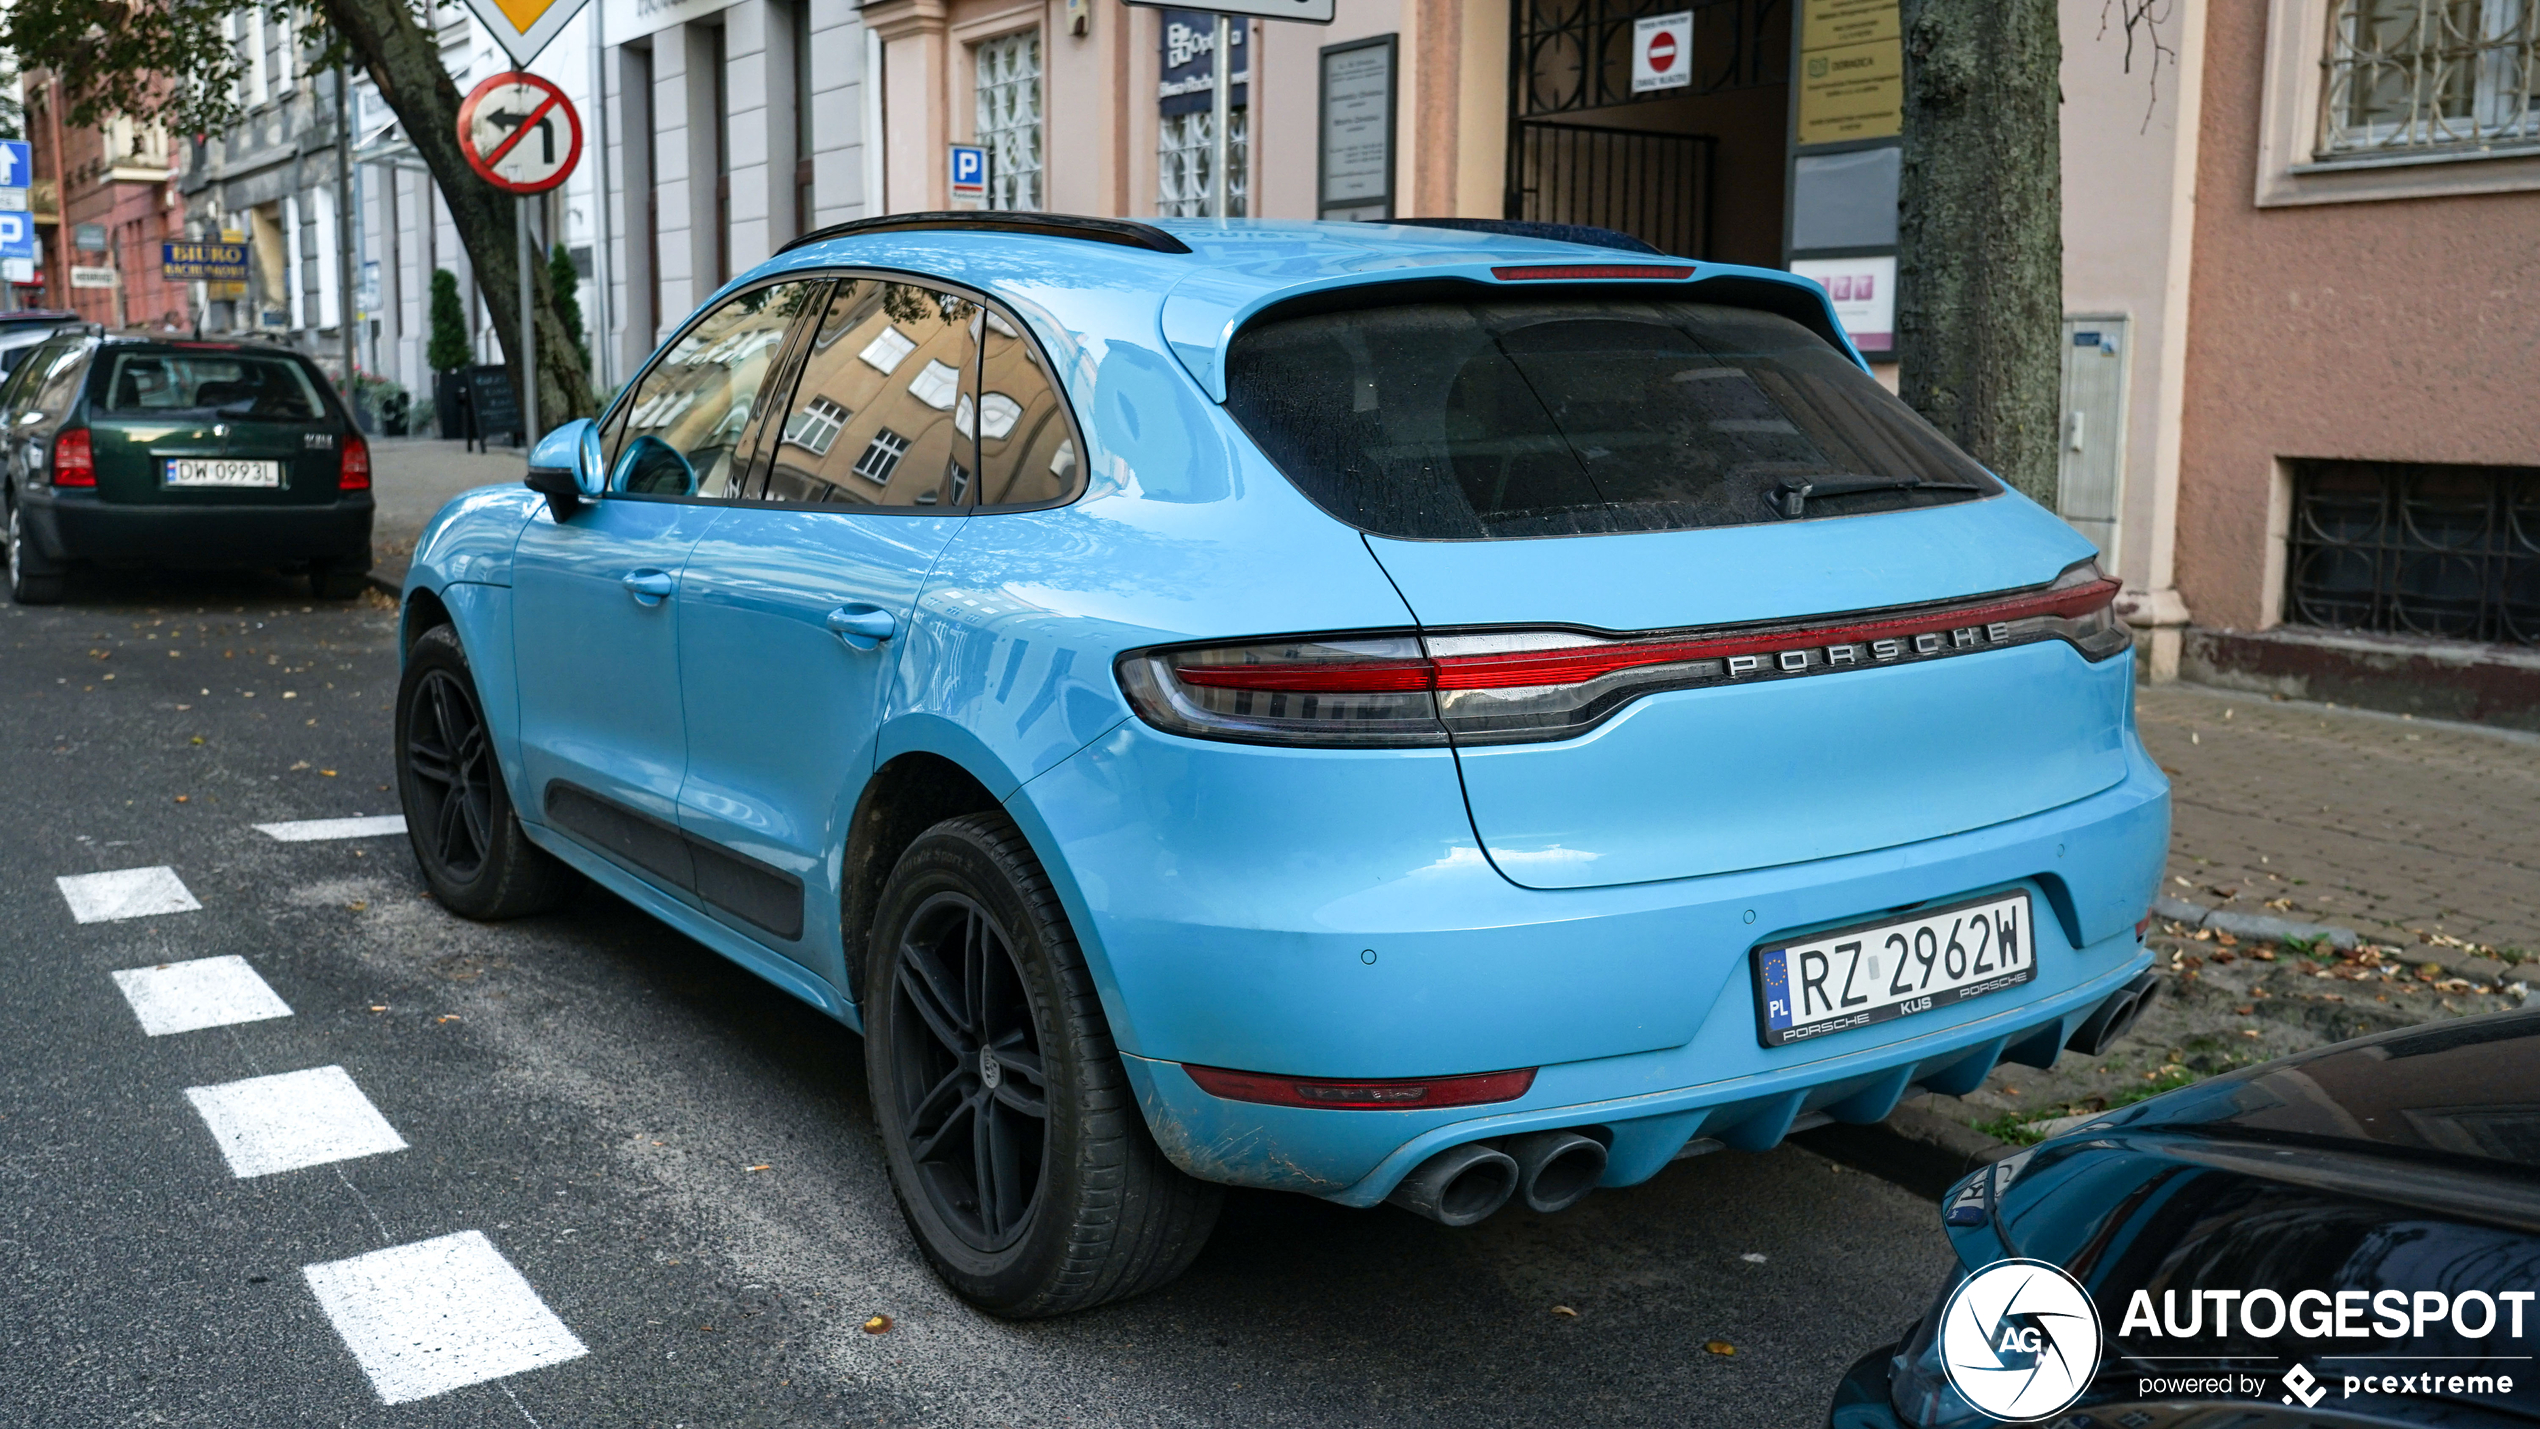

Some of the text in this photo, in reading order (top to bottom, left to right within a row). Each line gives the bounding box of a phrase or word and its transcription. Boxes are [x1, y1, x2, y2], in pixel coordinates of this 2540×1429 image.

[959, 151, 977, 180] P
[172, 245, 242, 263] BIURO
[179, 462, 275, 481] DW 0993L
[1726, 621, 2010, 679] PORSCHE
[1799, 905, 2019, 1016] RZ 2962W
[1769, 998, 1789, 1019] PL
[1783, 972, 2028, 1041] PORSCHE KUS PORSCHE
